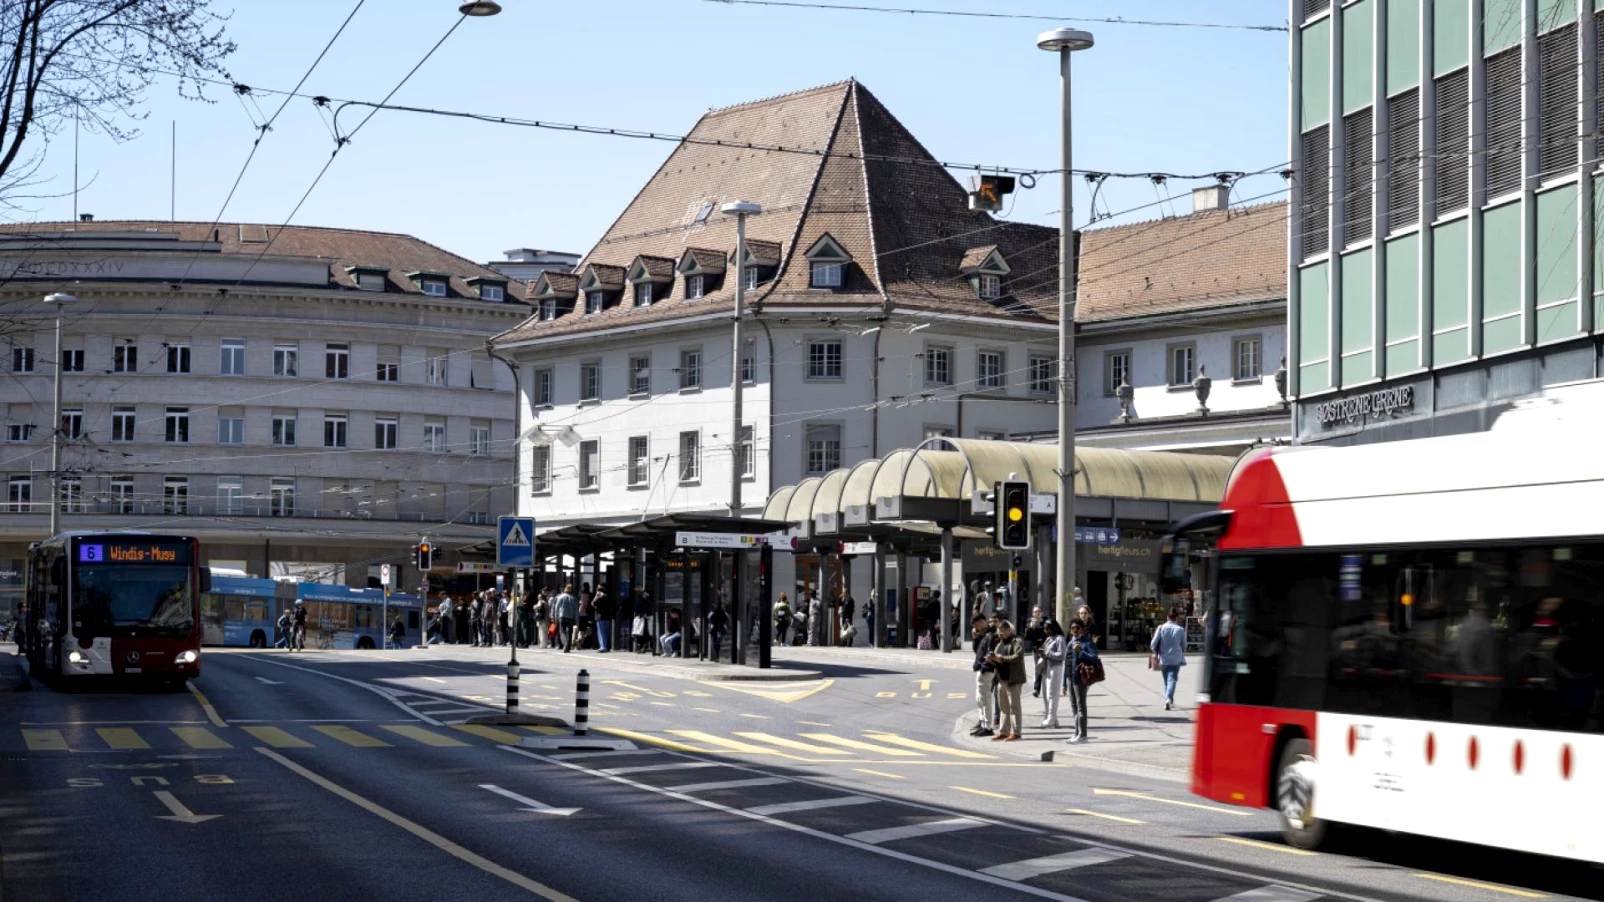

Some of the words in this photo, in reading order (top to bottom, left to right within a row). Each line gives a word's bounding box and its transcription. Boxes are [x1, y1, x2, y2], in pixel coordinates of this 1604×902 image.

[1316, 394, 1371, 423] SØSTRENE
[1372, 385, 1412, 418] GRENE
[87, 546, 95, 560] 6
